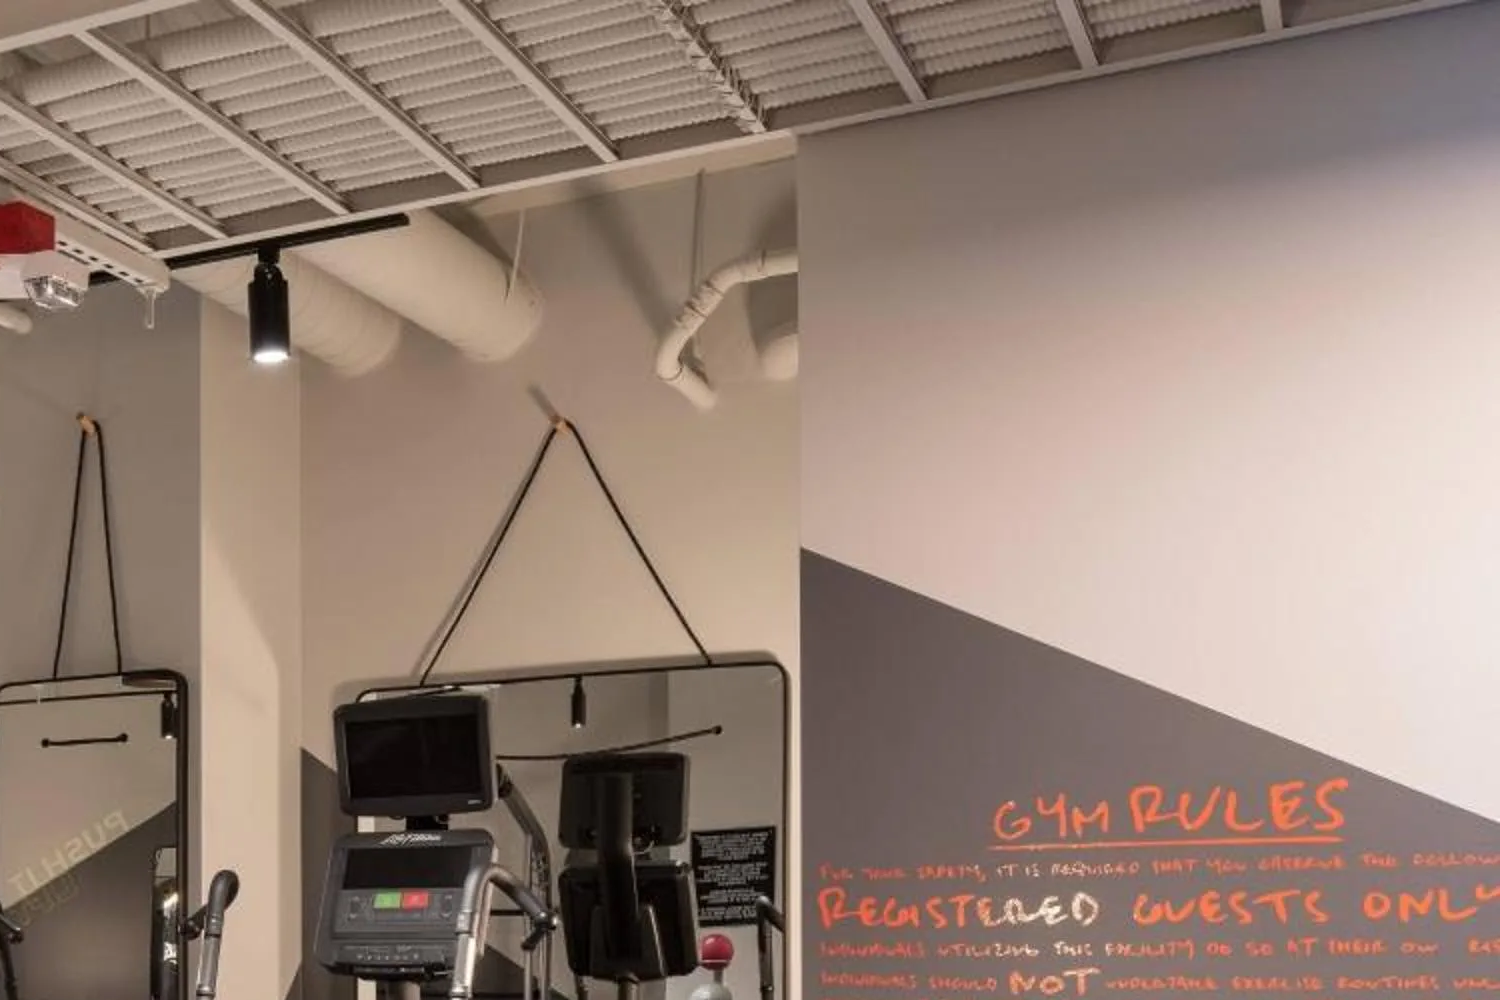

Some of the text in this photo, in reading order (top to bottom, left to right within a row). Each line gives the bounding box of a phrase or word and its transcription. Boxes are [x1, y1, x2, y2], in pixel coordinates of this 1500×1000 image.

[994, 778, 1349, 841] GYM RULES
[996, 862, 1017, 877] IT
[1025, 862, 1041, 877] IS
[816, 886, 1100, 929] REGISTERED
[1132, 889, 1330, 926] GUESTS
[937, 941, 1040, 958] UTILIZING
[1053, 940, 1094, 957] THIS
[1105, 939, 1195, 961] FACILITY
[1244, 940, 1274, 957] SO
[1286, 936, 1319, 957] AT
[1008, 966, 1101, 997] NOT
